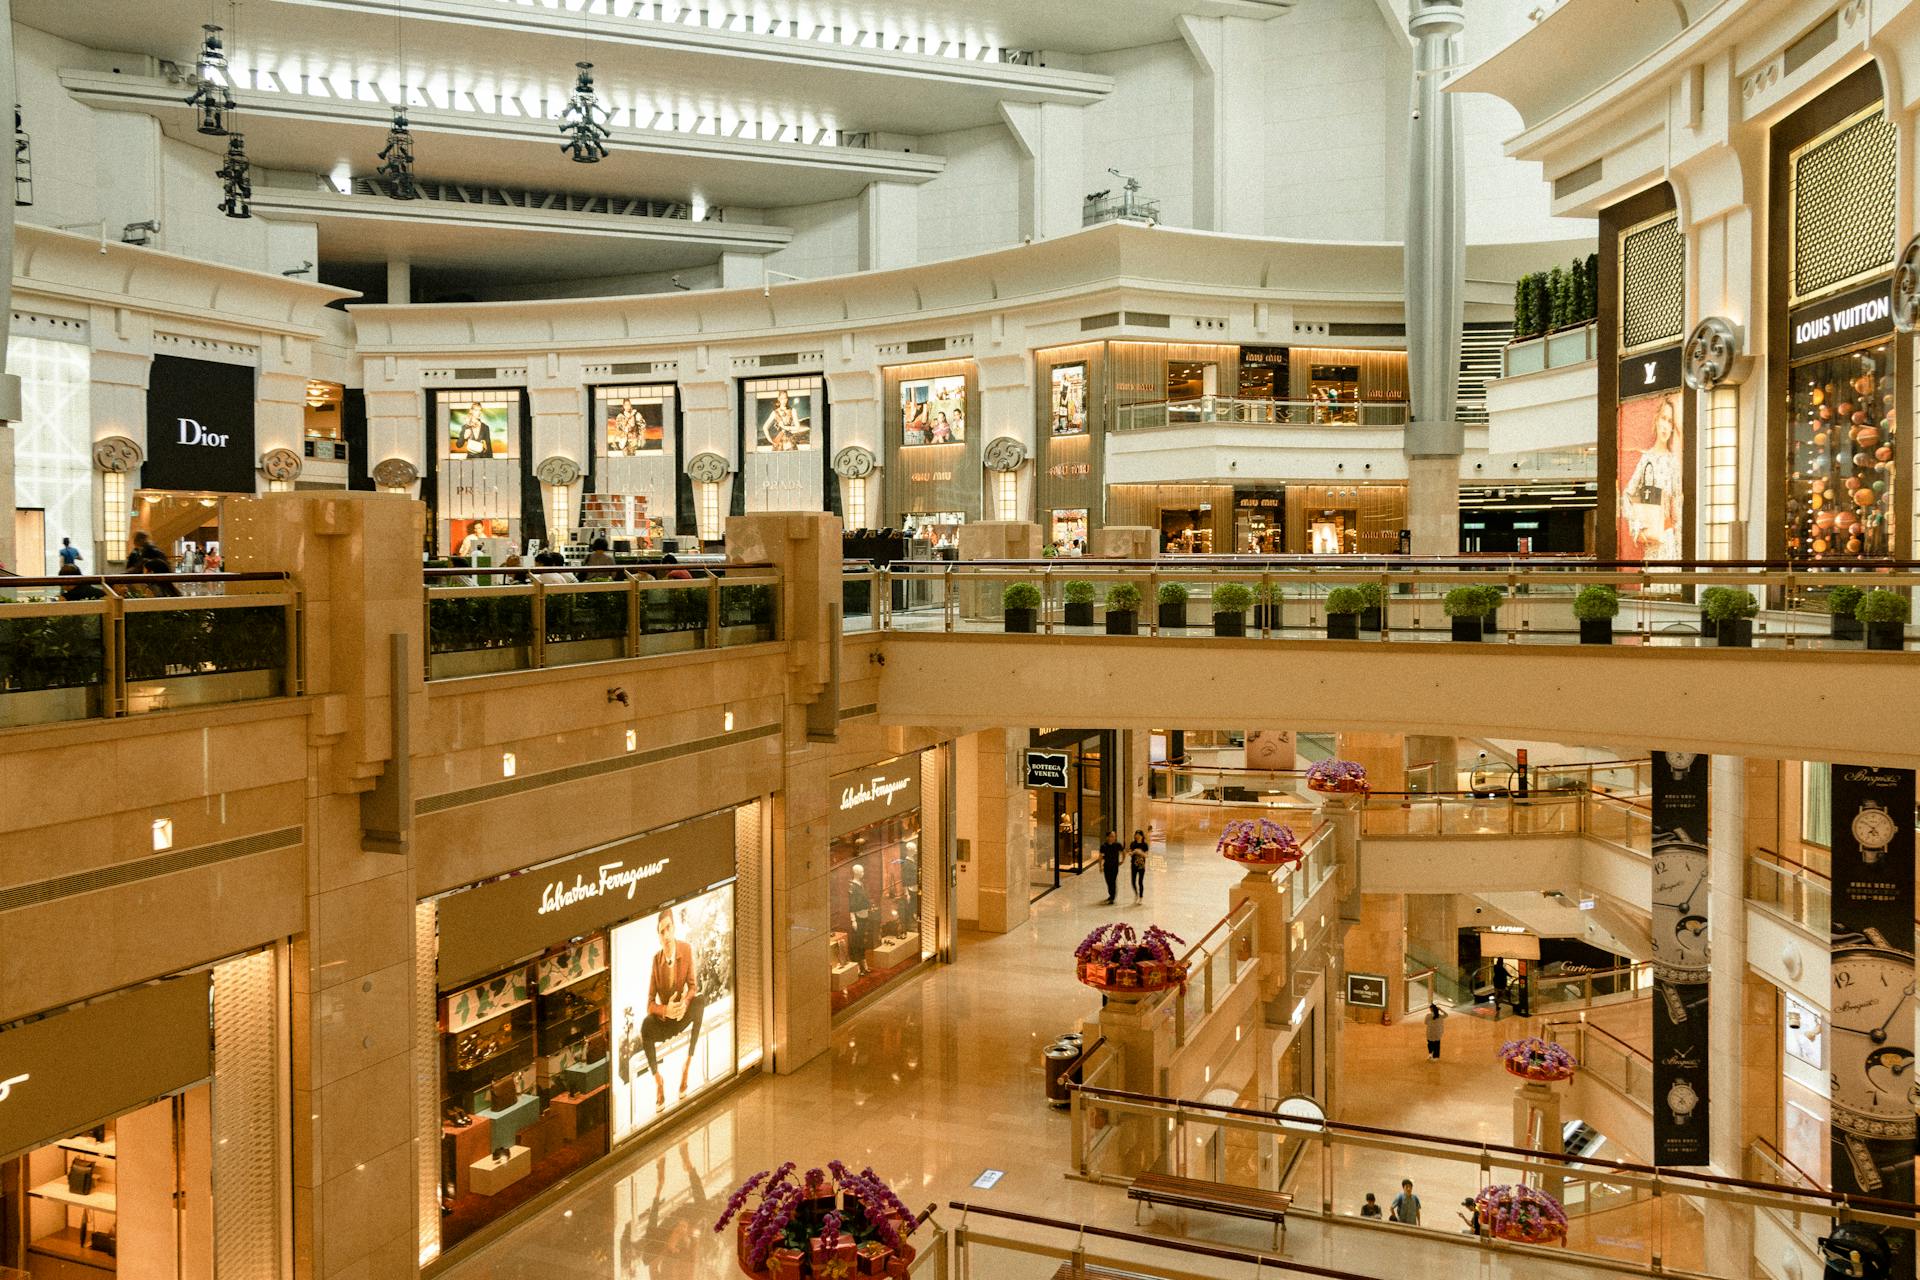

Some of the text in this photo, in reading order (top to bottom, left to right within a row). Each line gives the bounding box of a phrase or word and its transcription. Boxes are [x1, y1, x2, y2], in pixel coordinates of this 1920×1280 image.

[1796, 296, 1889, 344] LOUIS VUITTON
[176, 417, 230, 448] Dior
[1031, 763, 1062, 772] BOTTEGA
[1033, 770, 1060, 778] VENETA
[839, 776, 912, 811] Salvatore Ferragamo
[537, 857, 671, 916] Salvatore Ferragamo
[1833, 971, 1856, 990] 12
